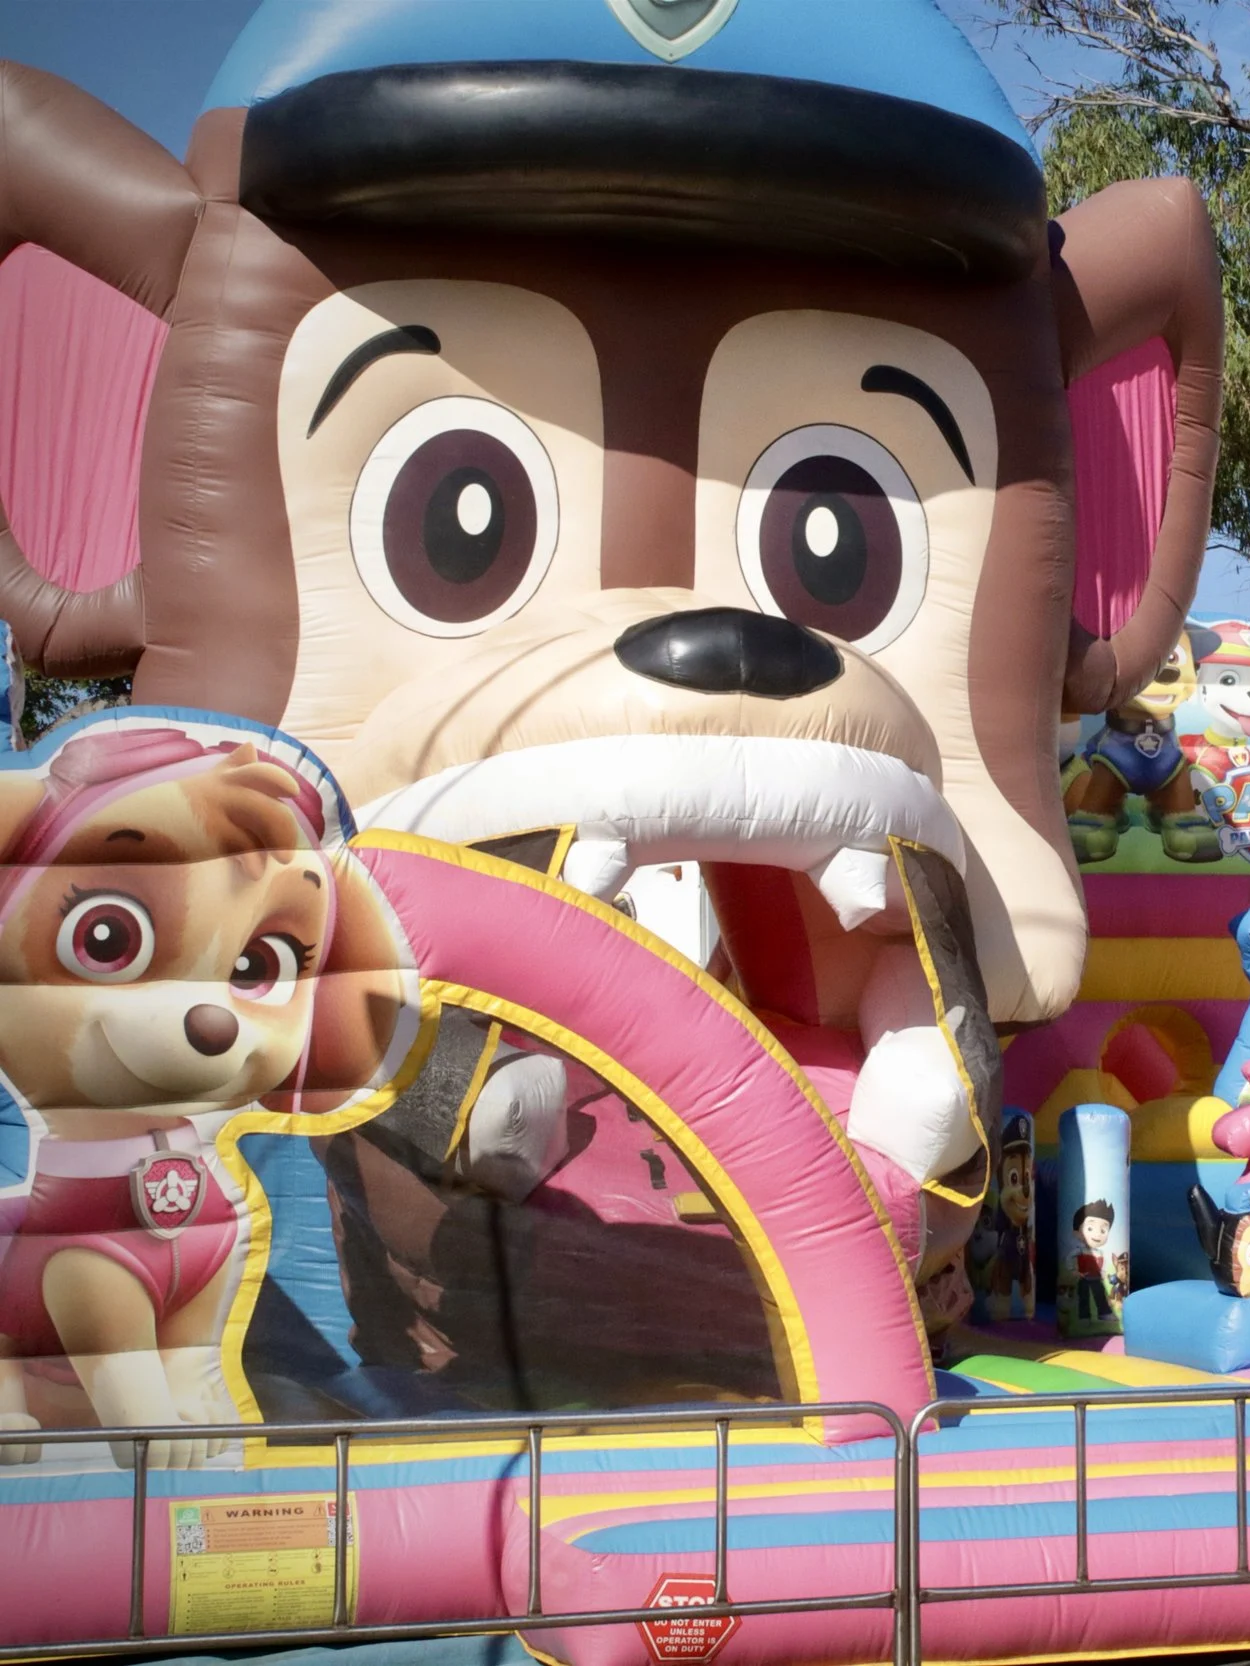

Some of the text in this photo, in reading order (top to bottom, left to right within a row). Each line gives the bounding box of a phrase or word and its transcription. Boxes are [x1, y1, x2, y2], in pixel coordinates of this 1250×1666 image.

[226, 1506, 305, 1518] WARNING
[225, 1581, 275, 1590] OPERATING
[654, 1618, 722, 1628] DO NOT ENTER
[669, 1627, 706, 1636] UNLESS
[656, 1636, 717, 1645] OPERATOR IS
[664, 1645, 706, 1653] ON DUTY
